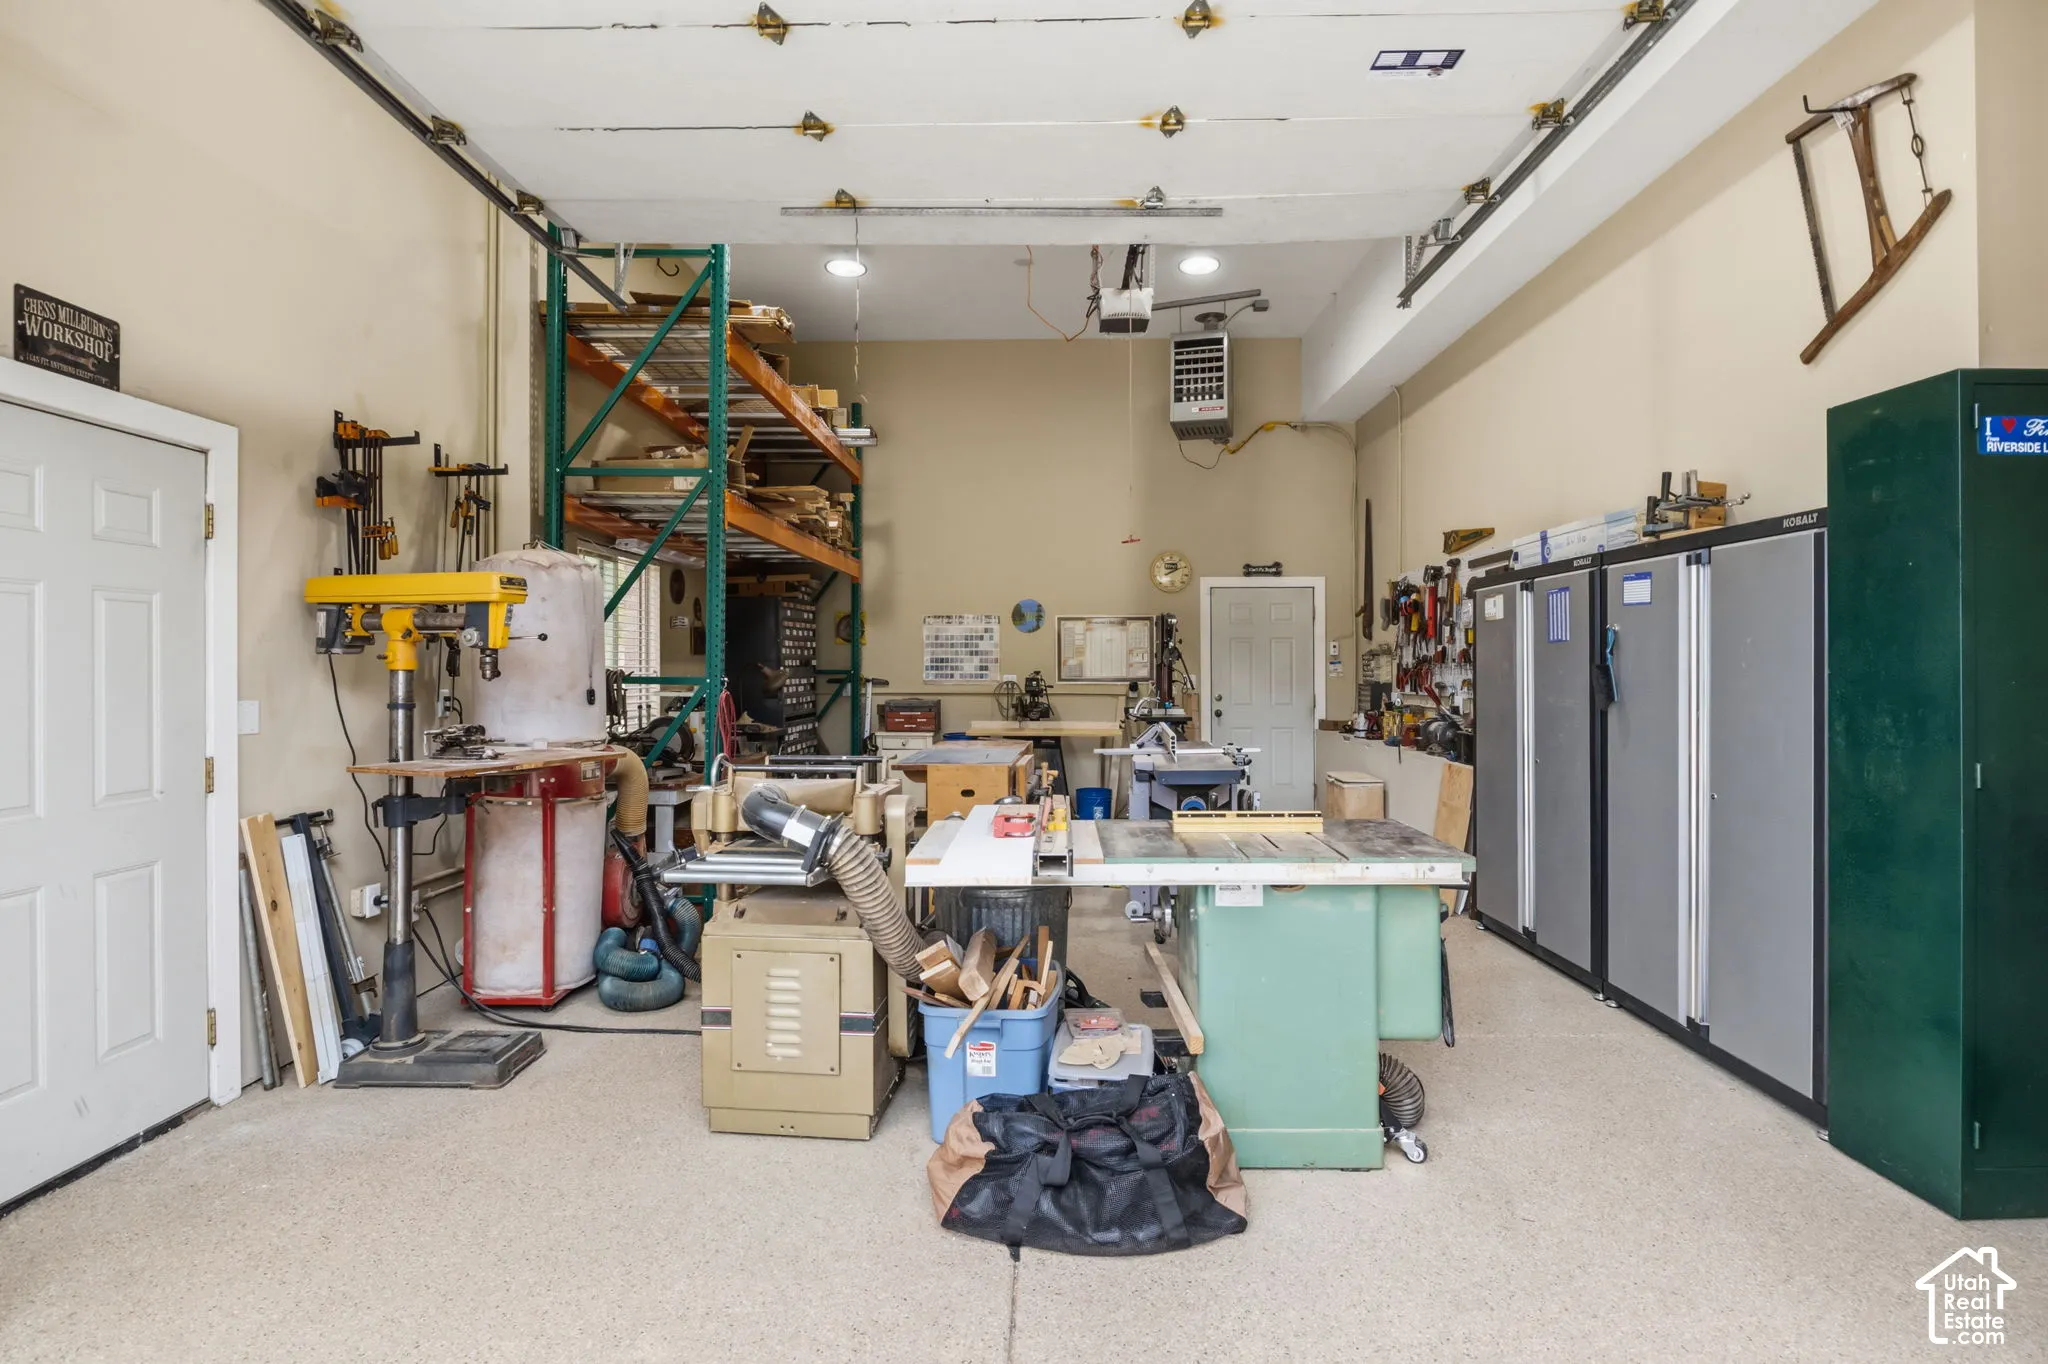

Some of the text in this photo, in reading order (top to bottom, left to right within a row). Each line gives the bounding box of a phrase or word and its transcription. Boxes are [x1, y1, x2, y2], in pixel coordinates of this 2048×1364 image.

[24, 297, 113, 342] CHESS MILLBURN'S
[24, 312, 114, 363] WORKSHOP
[1985, 416, 1992, 436] I
[1986, 441, 2042, 453] RIVERSIDE
[1782, 512, 1819, 529] KOBALT
